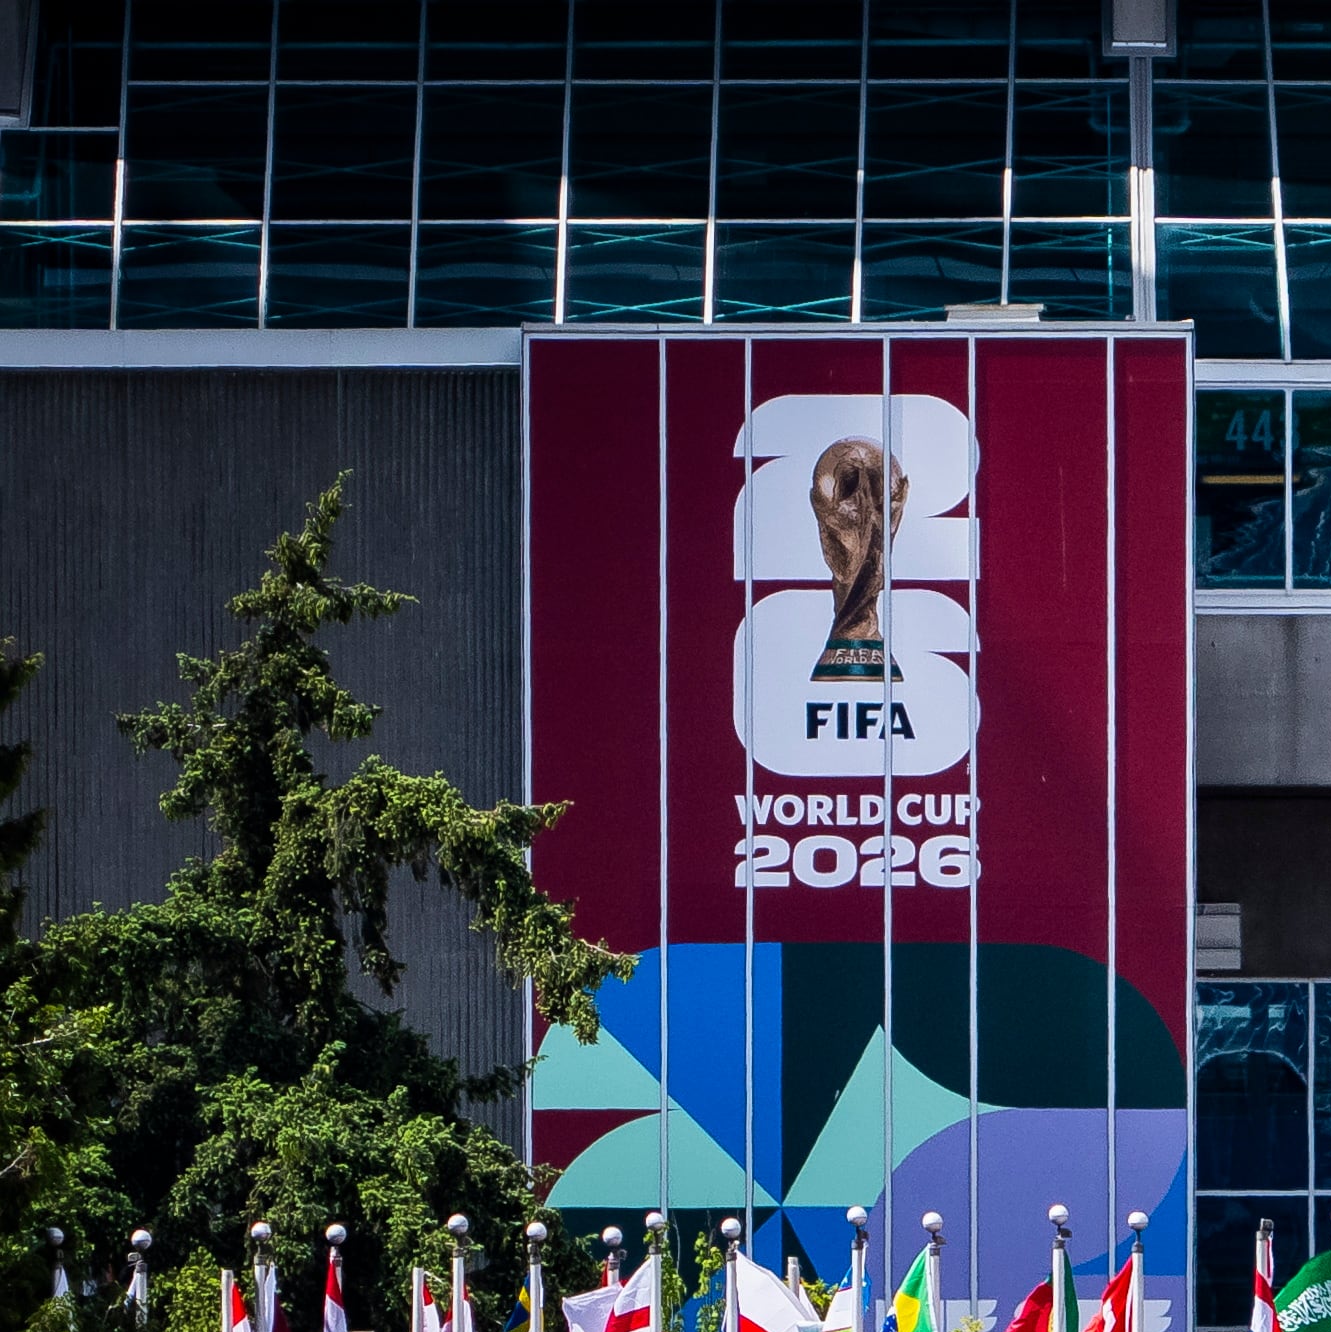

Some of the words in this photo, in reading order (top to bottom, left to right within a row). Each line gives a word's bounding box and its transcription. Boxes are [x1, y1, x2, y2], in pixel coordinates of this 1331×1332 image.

[805, 701, 916, 740] FIFA
[734, 794, 887, 826] WORLD
[896, 793, 982, 827] CUP
[734, 835, 982, 888] 2026
